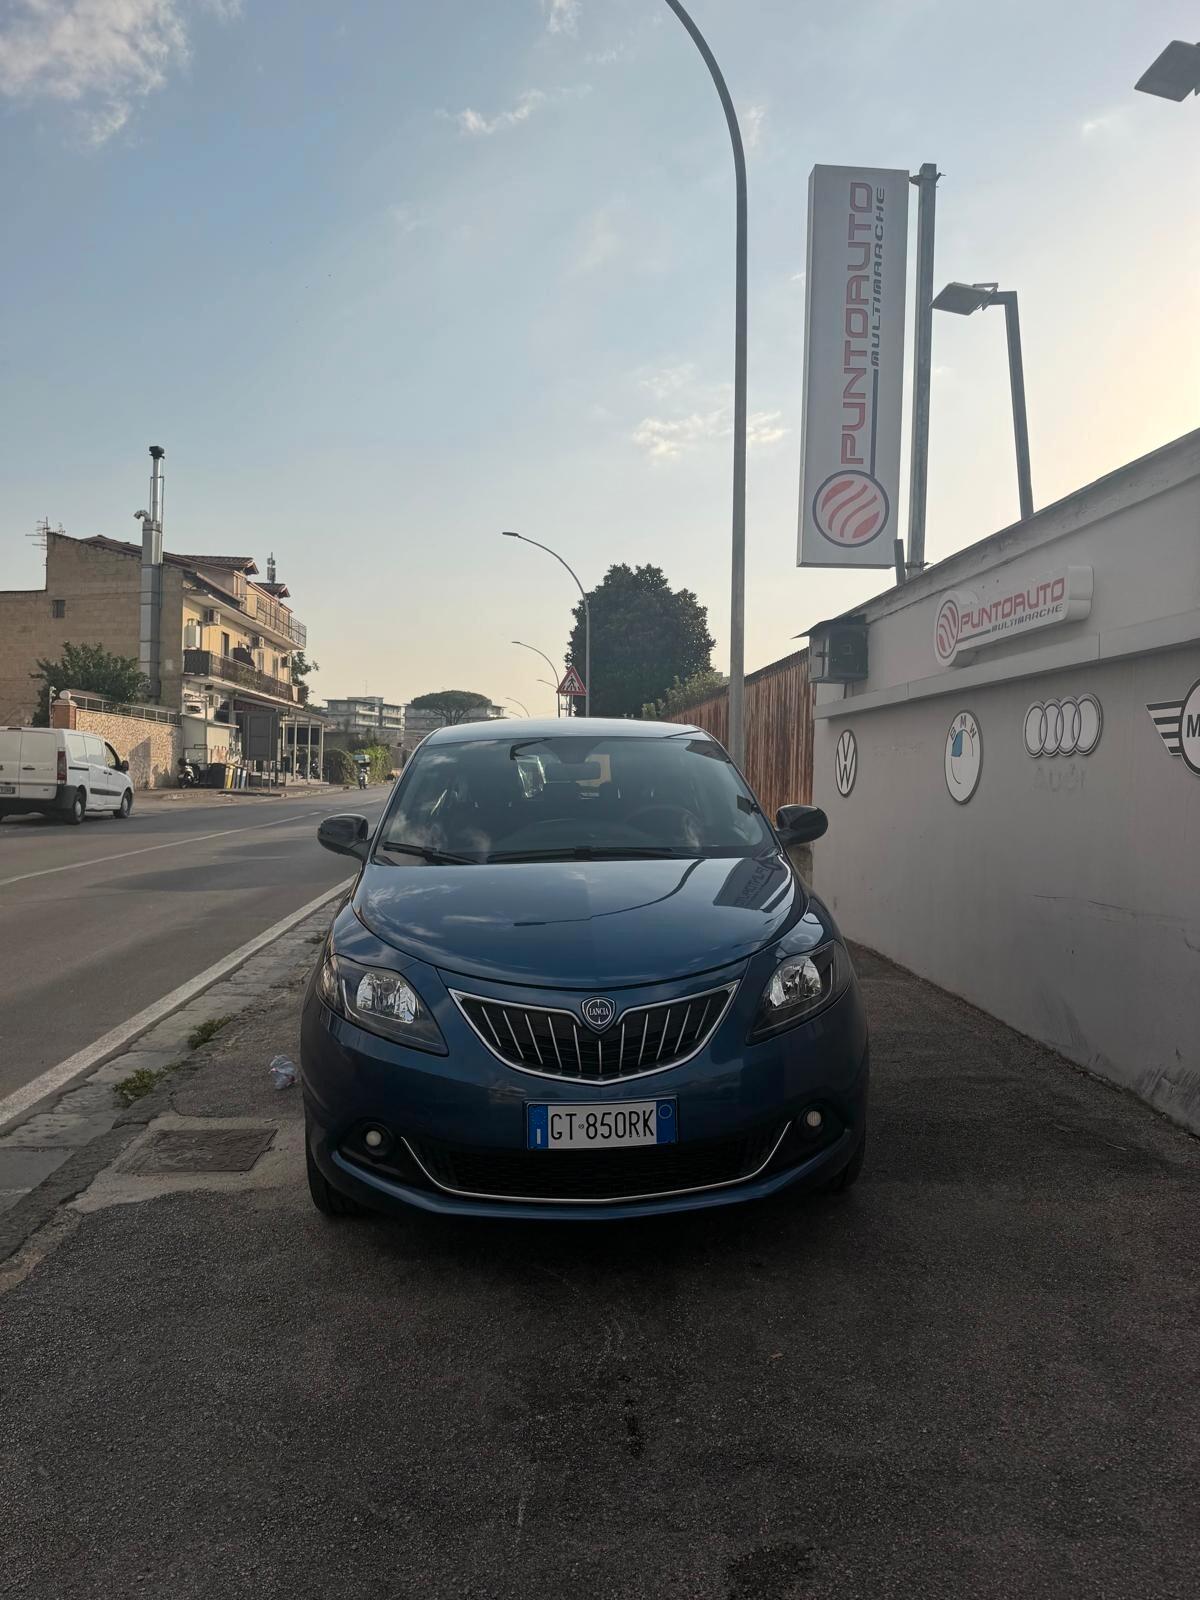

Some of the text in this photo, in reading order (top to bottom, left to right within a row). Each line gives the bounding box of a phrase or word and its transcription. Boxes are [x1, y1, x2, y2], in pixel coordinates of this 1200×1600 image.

[871, 186, 885, 367] MULTIMARCHE
[841, 181, 873, 465] PUNTOAUTO
[960, 577, 1065, 633] PUNTOAUTO
[991, 602, 1063, 633] MULTIMARCHE
[589, 1007, 609, 1016] LANCIA
